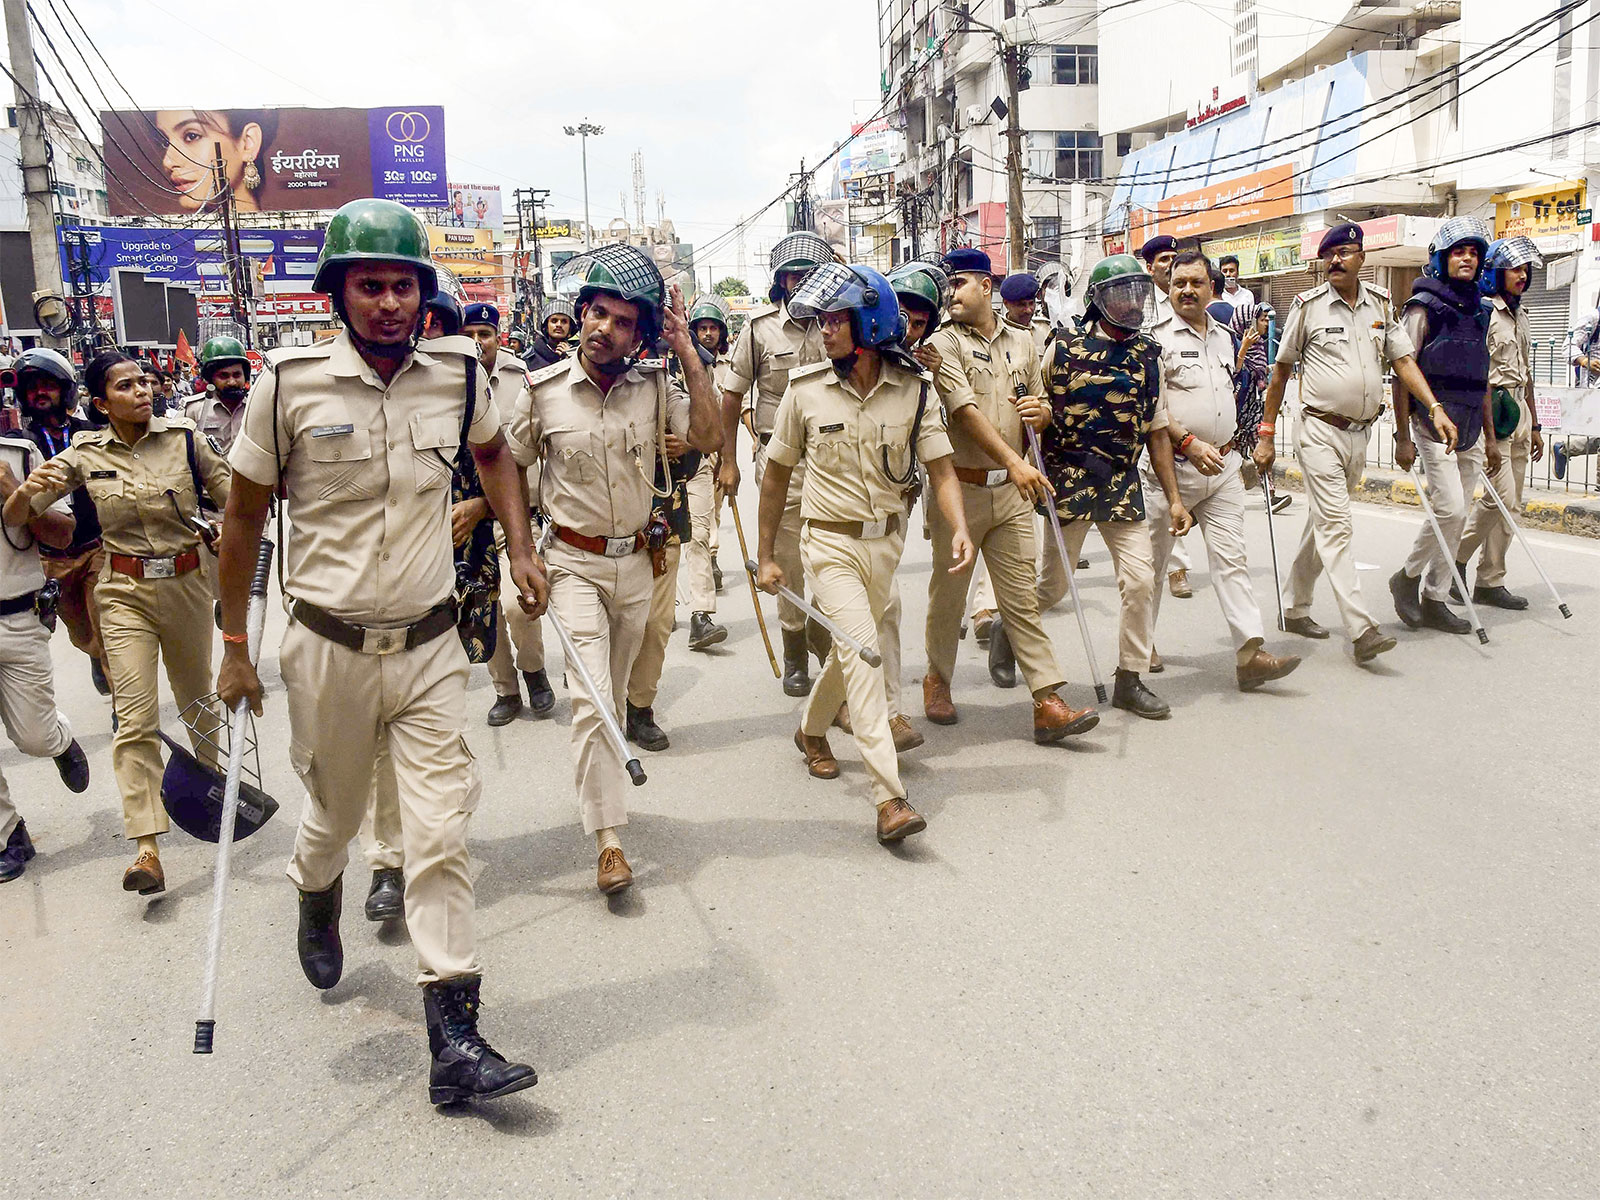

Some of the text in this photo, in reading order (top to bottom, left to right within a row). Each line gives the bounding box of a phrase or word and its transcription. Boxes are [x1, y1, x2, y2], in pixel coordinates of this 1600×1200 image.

[394, 144, 425, 157] PNG
[1240, 182, 1264, 204] Baroda
[1505, 217, 1525, 229] BOOKS
[1497, 227, 1532, 240] STATIONERY
[121, 241, 171, 252] Upgrade to
[1228, 233, 1276, 252] COLLECTONS
[116, 253, 178, 265] Smart Cooling
